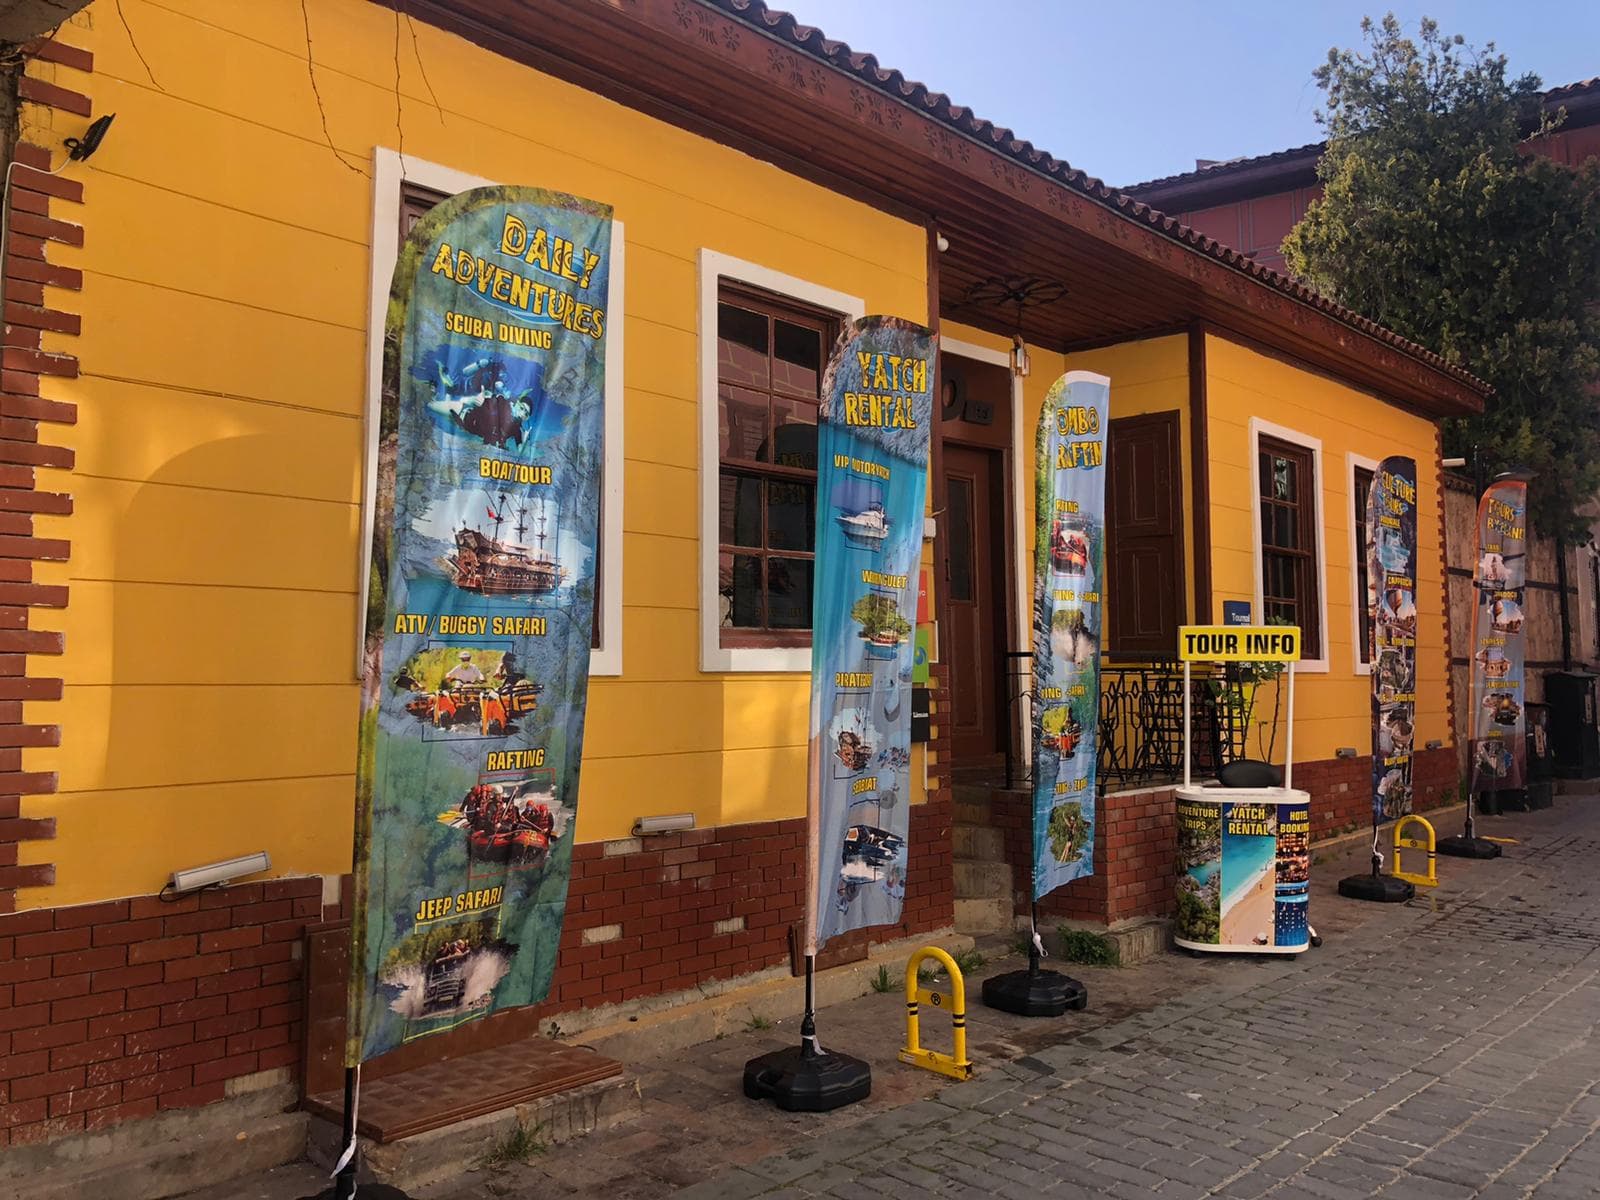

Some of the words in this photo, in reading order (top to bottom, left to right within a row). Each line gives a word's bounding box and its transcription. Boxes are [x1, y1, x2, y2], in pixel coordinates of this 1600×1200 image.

[500, 213, 600, 289] DAILY
[431, 243, 605, 340] ADVENTURES
[446, 312, 493, 340] SCUBA
[499, 324, 552, 350] DIVING
[857, 351, 927, 393] YATCH
[844, 392, 917, 429] RENTAL
[480, 458, 512, 481] BOAT
[514, 463, 552, 485] TOUR
[834, 454, 849, 468] VIP
[395, 614, 430, 634] ATV
[429, 616, 437, 636] /
[439, 615, 488, 635] BUGGY
[492, 616, 546, 636] SAFARI
[1184, 633, 1239, 655] TOUR
[1245, 633, 1295, 655] INFO
[487, 748, 545, 771] RAFTING
[1184, 818, 1207, 831] TRIPS
[1231, 806, 1266, 820] YATCH
[1289, 810, 1308, 821] HOTEL
[1228, 822, 1269, 835] RENTAL
[415, 899, 453, 921] JEEP
[455, 886, 503, 913] SAFARI
